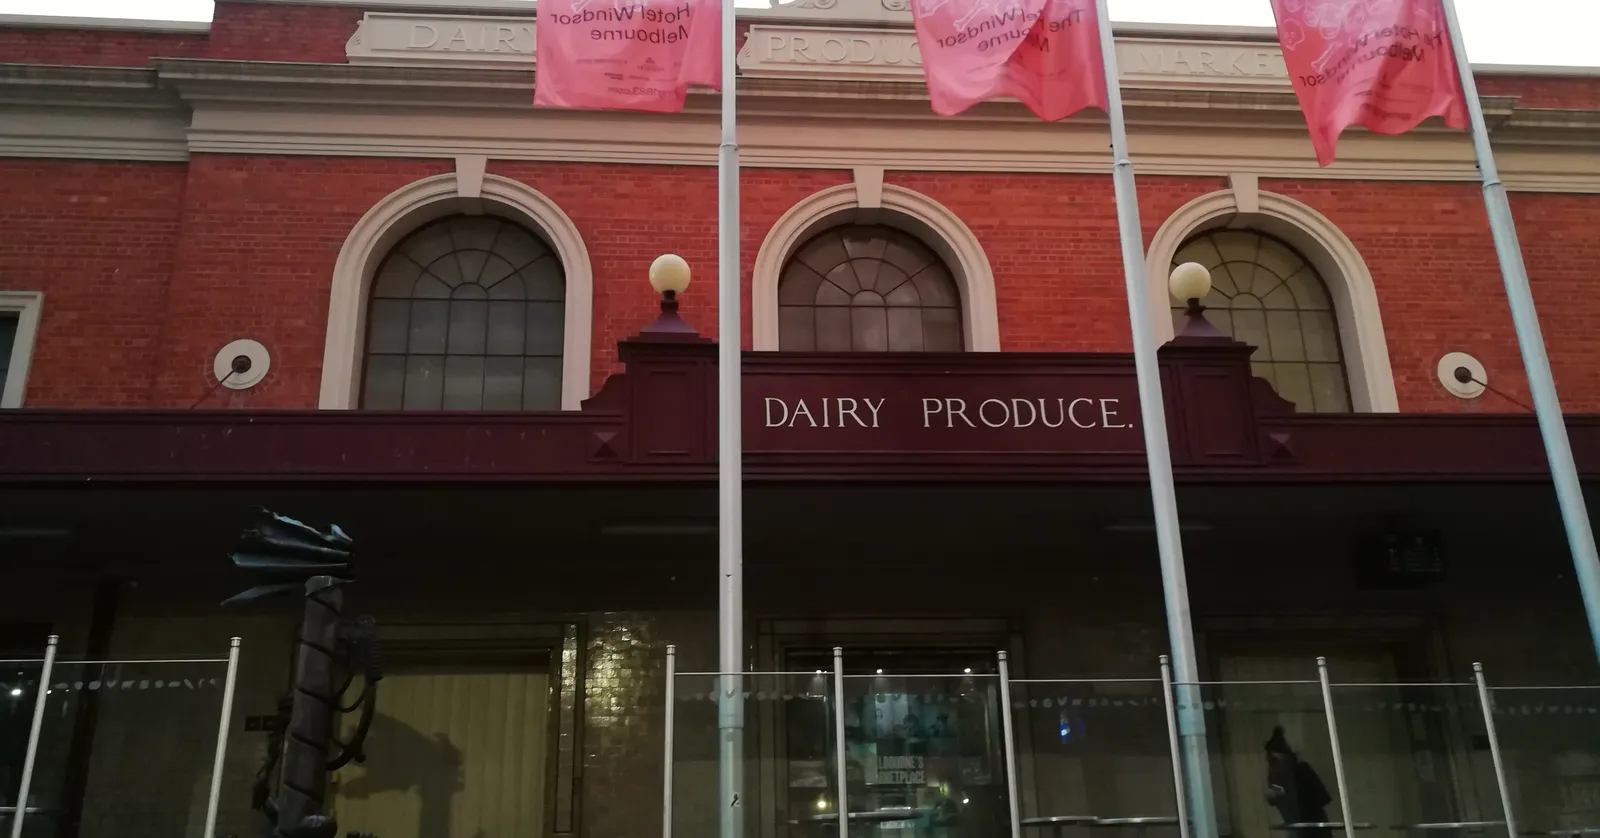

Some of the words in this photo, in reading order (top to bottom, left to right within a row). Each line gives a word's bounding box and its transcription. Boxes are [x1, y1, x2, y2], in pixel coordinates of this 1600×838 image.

[765, 36, 923, 65] PRODUC
[764, 398, 885, 428] DAIRY
[922, 398, 1134, 429] PRODUCE.
